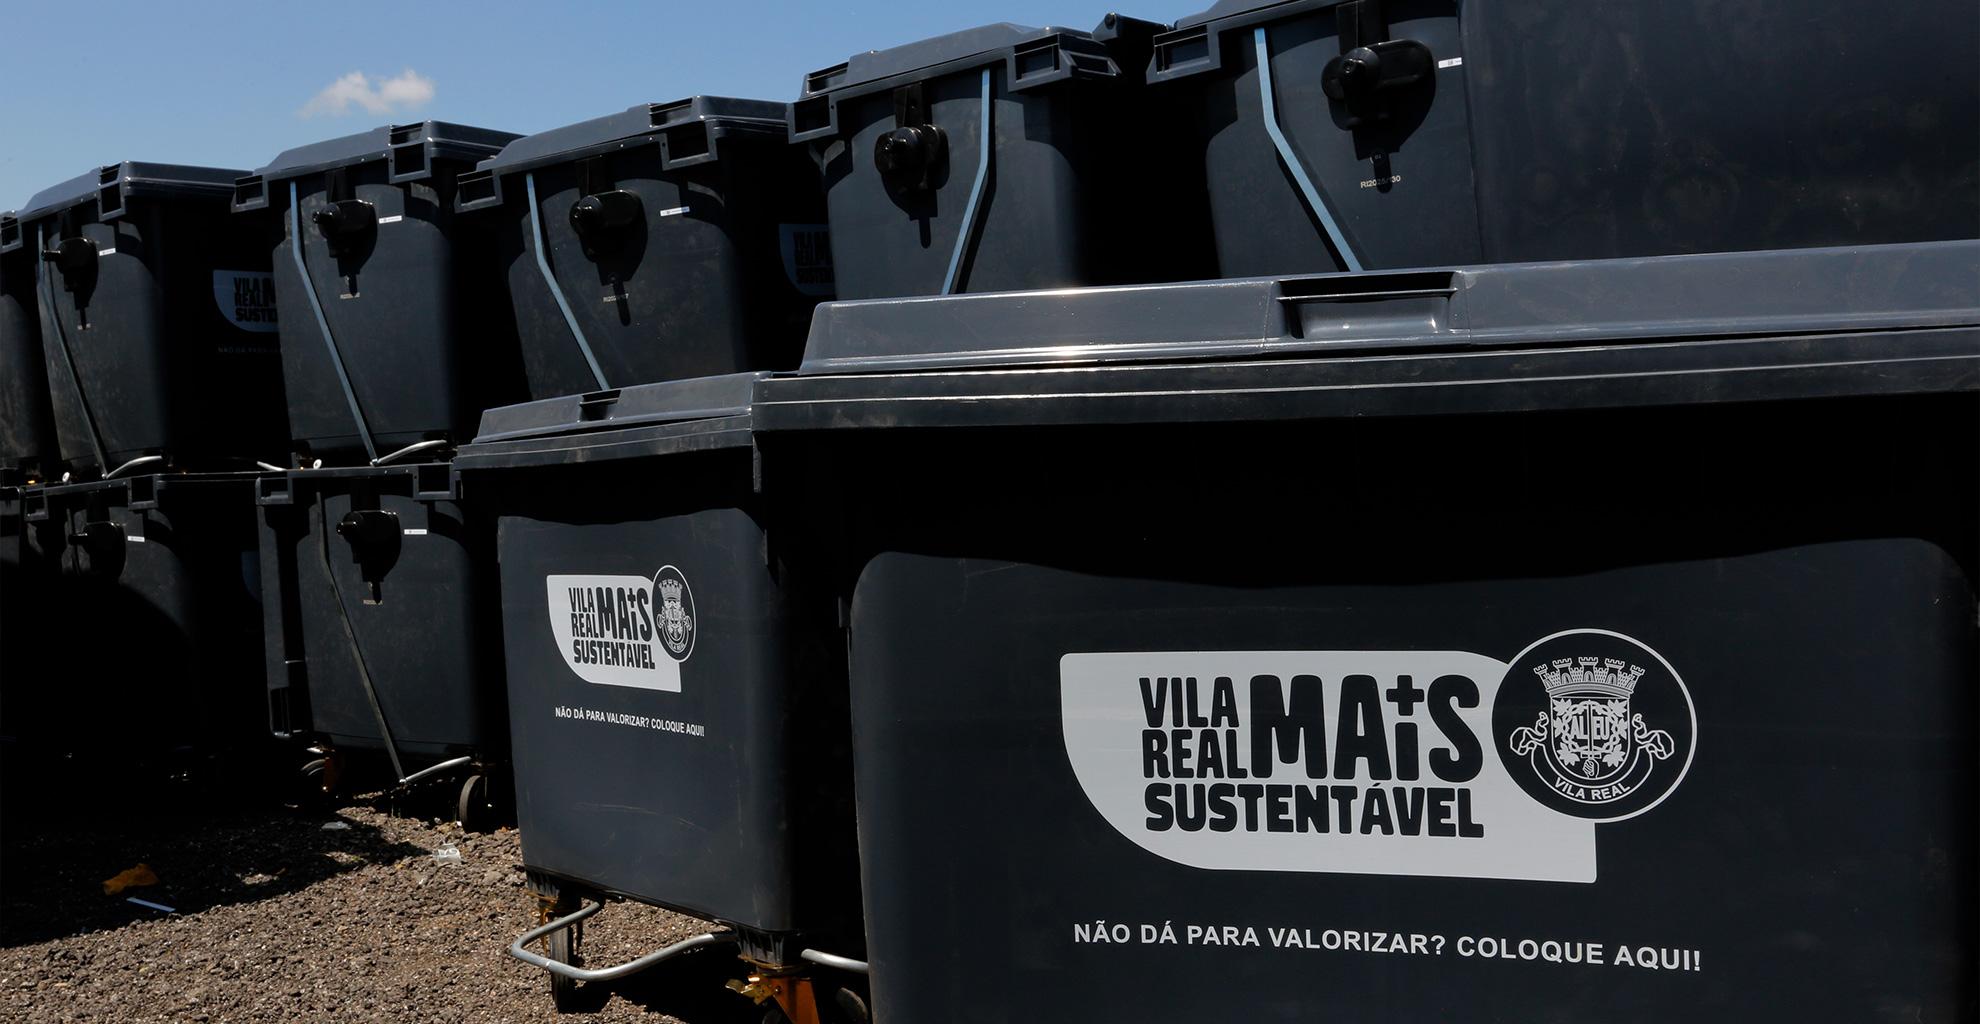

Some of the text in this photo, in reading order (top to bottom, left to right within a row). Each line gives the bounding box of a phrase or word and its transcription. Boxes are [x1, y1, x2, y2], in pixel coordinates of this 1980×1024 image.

[234, 277, 261, 293] VILA
[235, 292, 263, 307] REAL
[569, 588, 595, 613] VILA
[571, 613, 599, 638] REAL
[574, 640, 656, 669] SUSTENTÁVEL
[1139, 677, 1240, 728] VILA
[555, 705, 705, 737] NÃO DÁ PARA VALORIZAR? COLOQUE AQUI!
[1142, 729, 1248, 779] REAL
[1554, 777, 1631, 800] VILA REAL
[1145, 782, 1485, 838] SUSTENTÁVEL
[1075, 920, 1700, 972] NÃO DÁ PARA VALORIZAR? COLOQUE AQUI!
